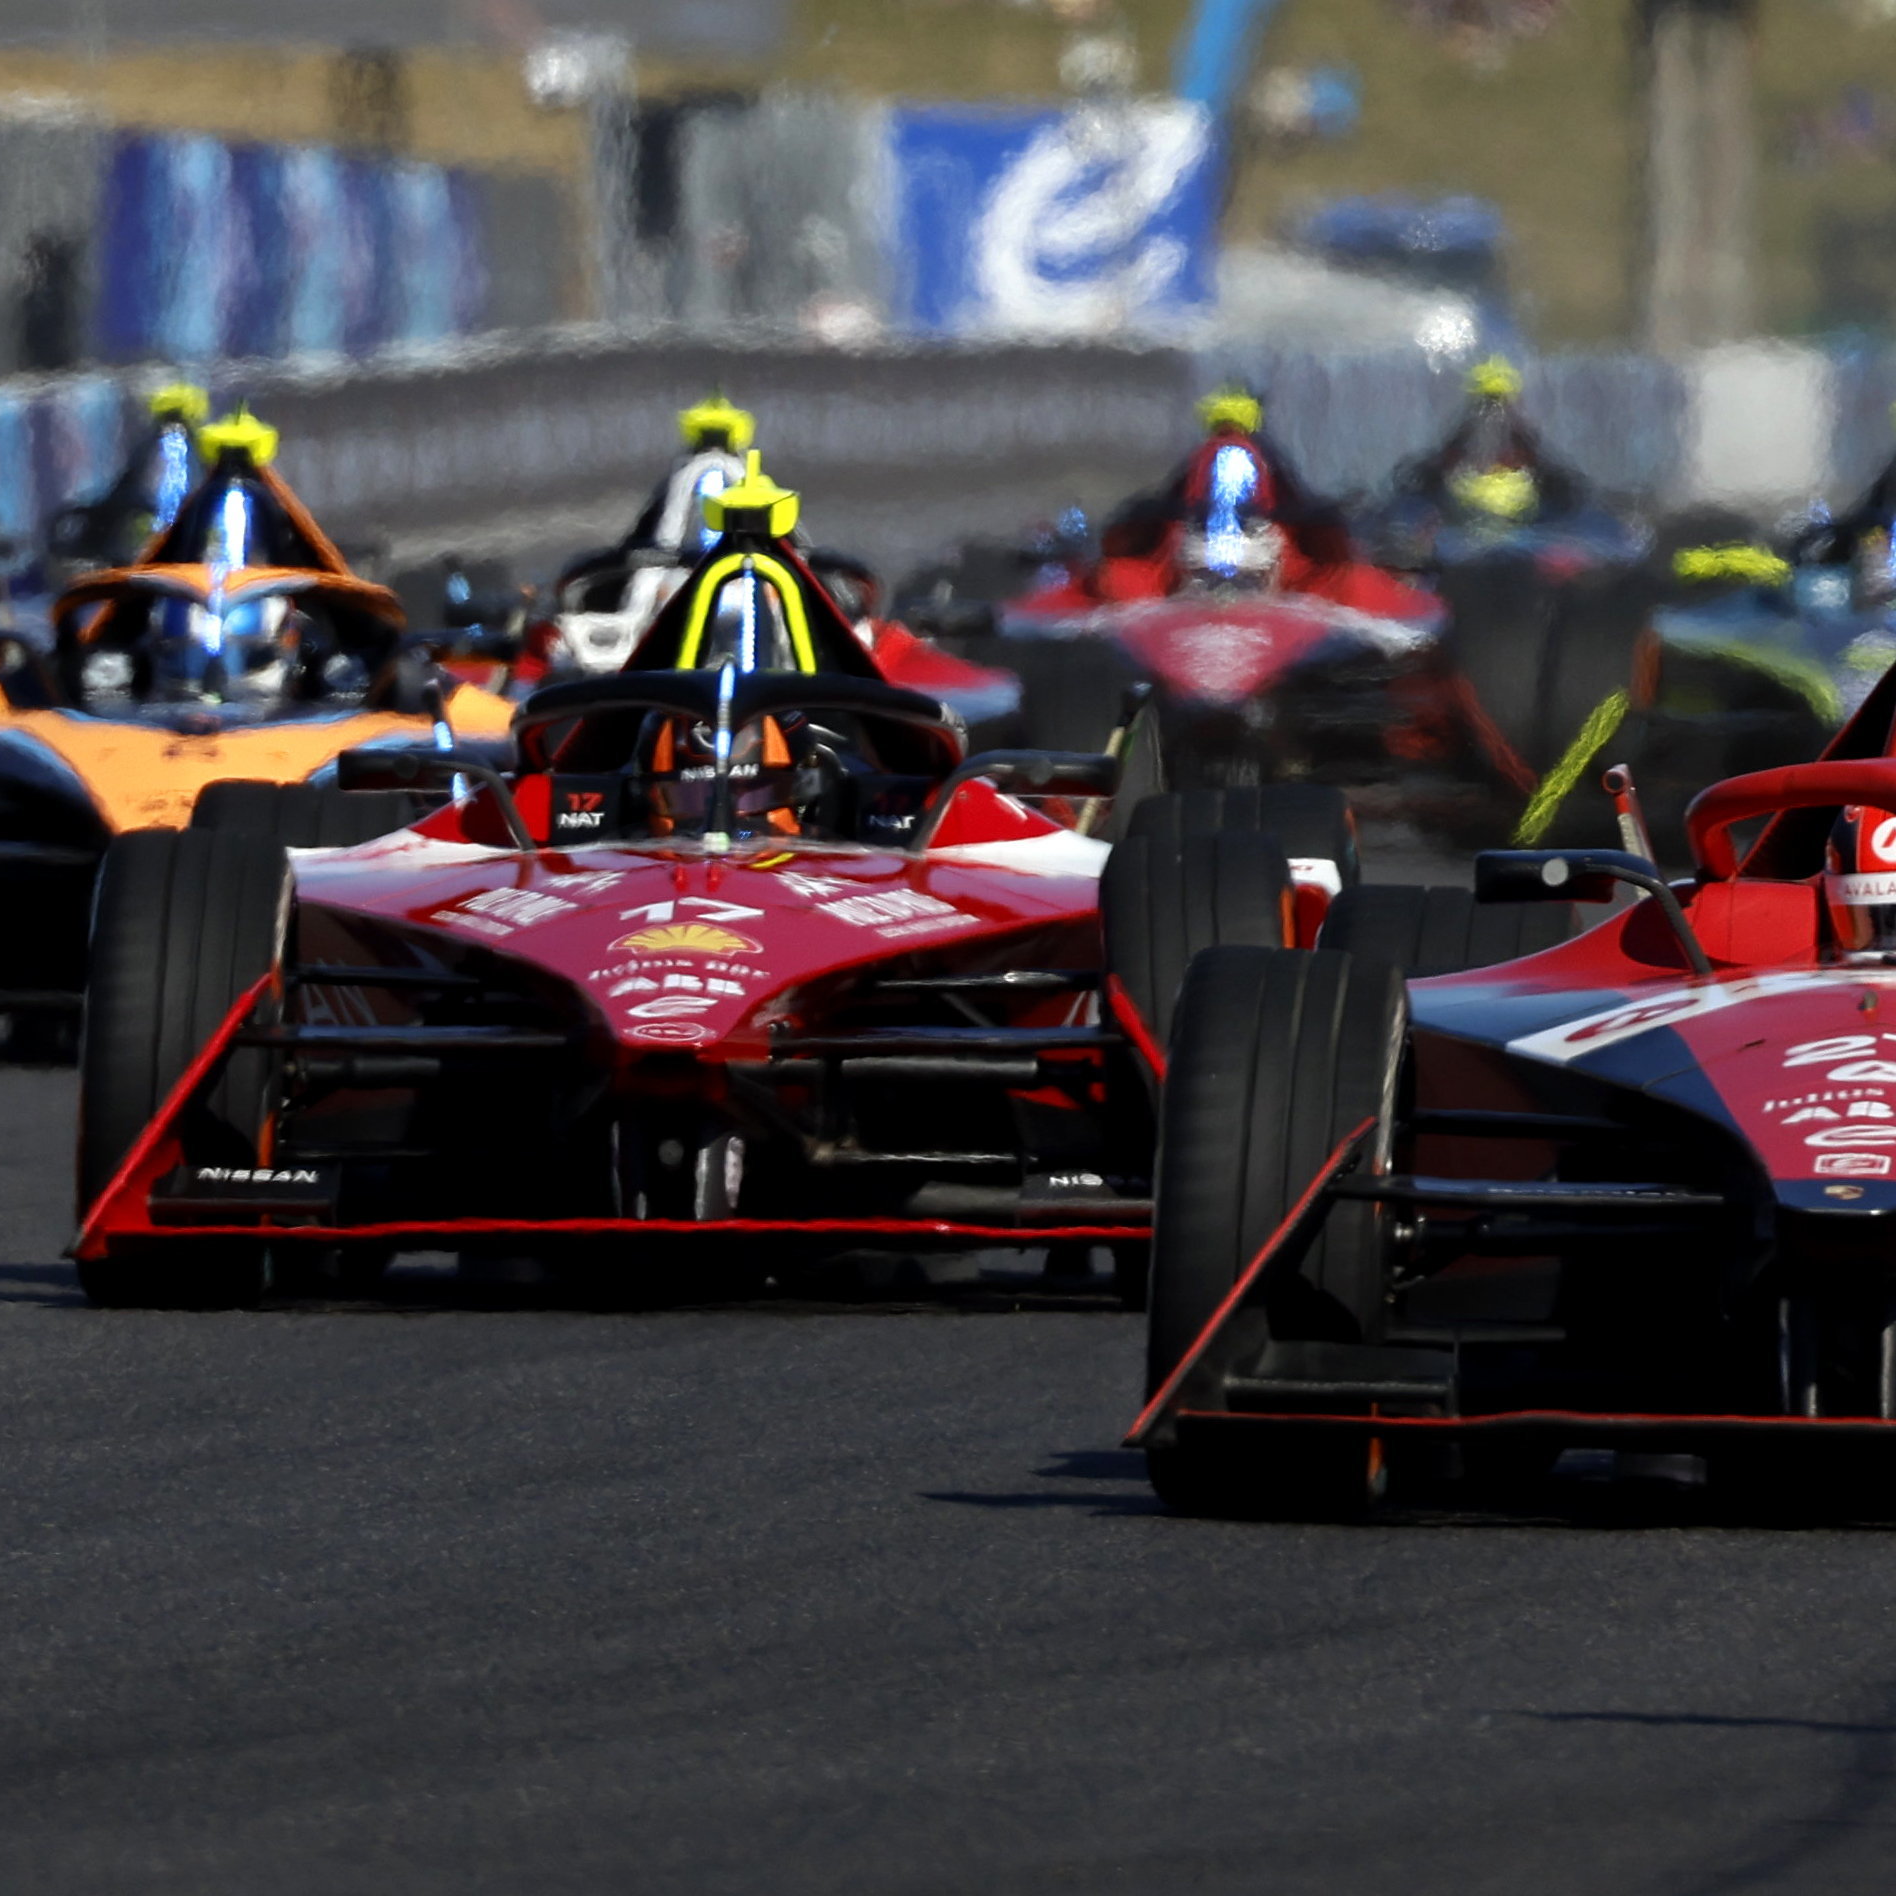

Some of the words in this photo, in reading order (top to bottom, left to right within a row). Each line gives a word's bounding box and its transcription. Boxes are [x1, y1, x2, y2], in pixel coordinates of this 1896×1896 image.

[681, 763, 760, 782] NISAN
[566, 791, 604, 812] 17
[557, 811, 606, 830] NAT
[618, 896, 766, 923] 17
[196, 1166, 320, 1185] NISSAN
